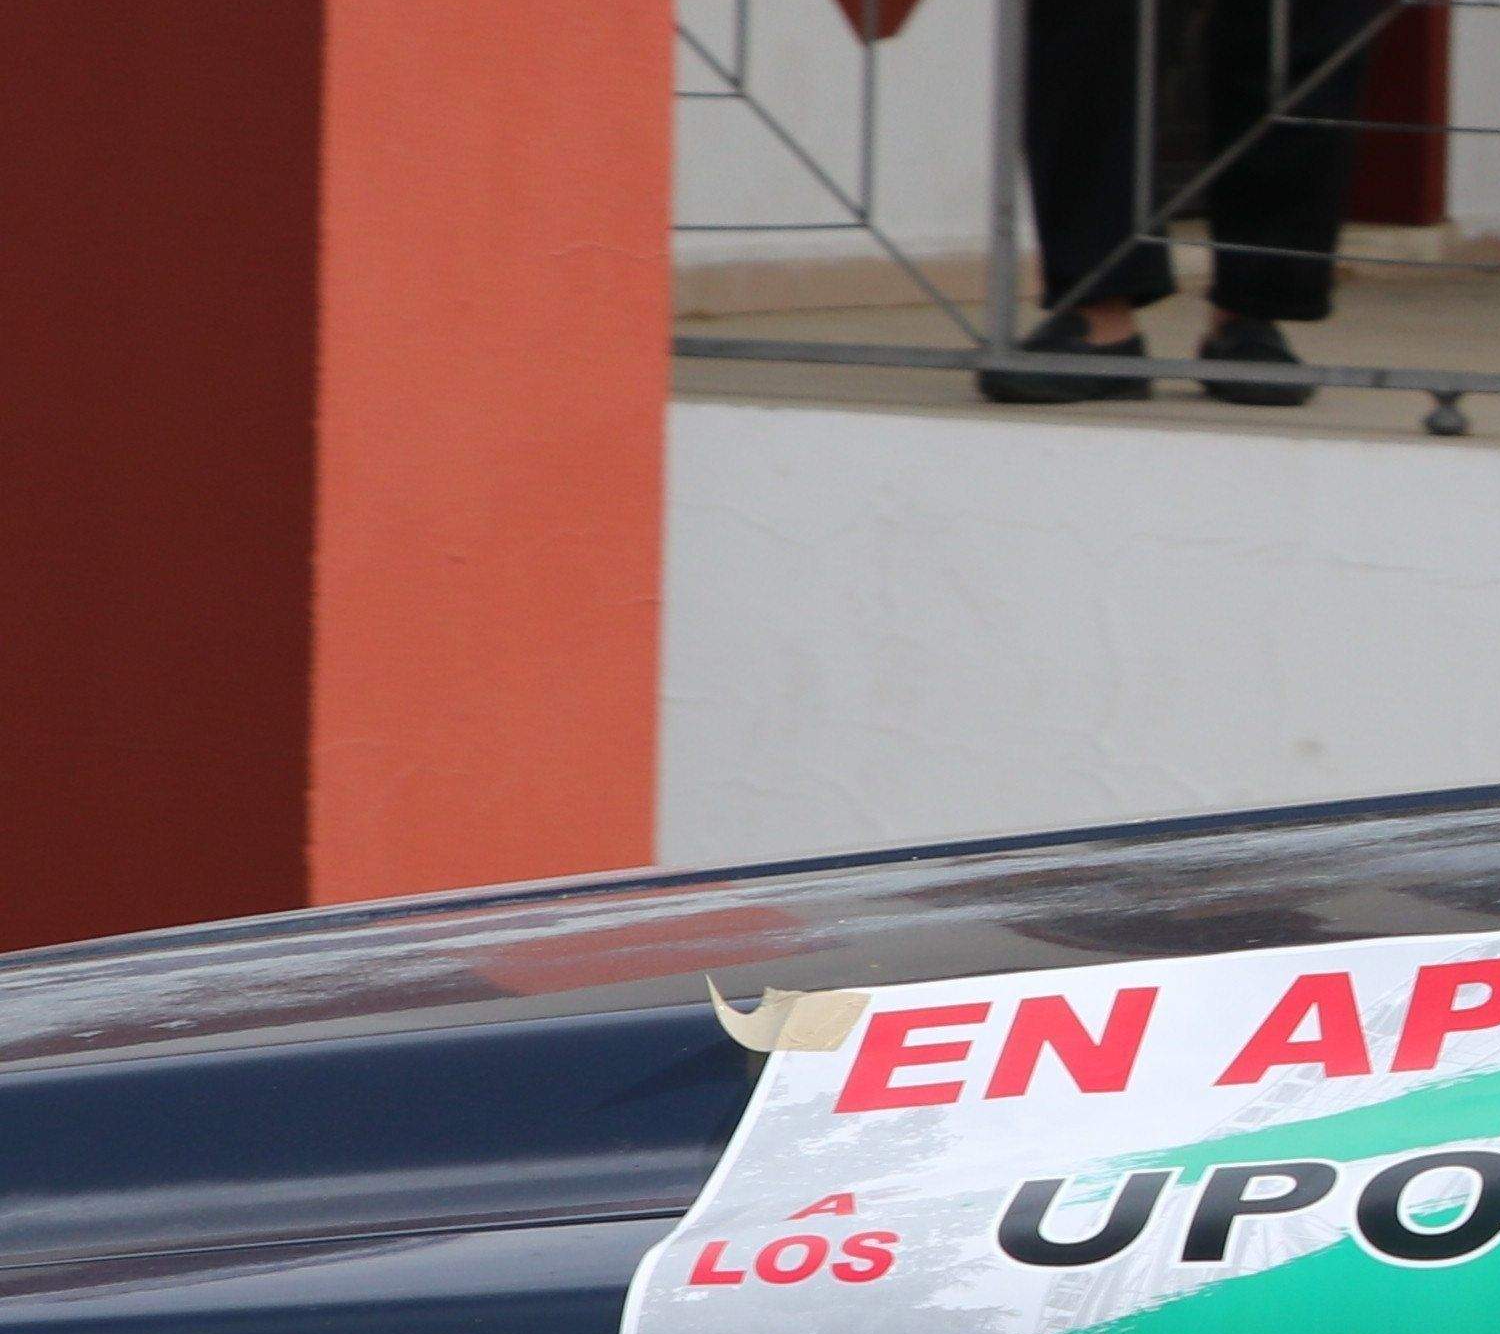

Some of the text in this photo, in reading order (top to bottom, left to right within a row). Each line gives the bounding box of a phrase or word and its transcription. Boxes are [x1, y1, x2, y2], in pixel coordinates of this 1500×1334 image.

[835, 986, 1157, 1114] EN
[787, 1191, 858, 1220] A
[688, 1231, 900, 1286] LOS
